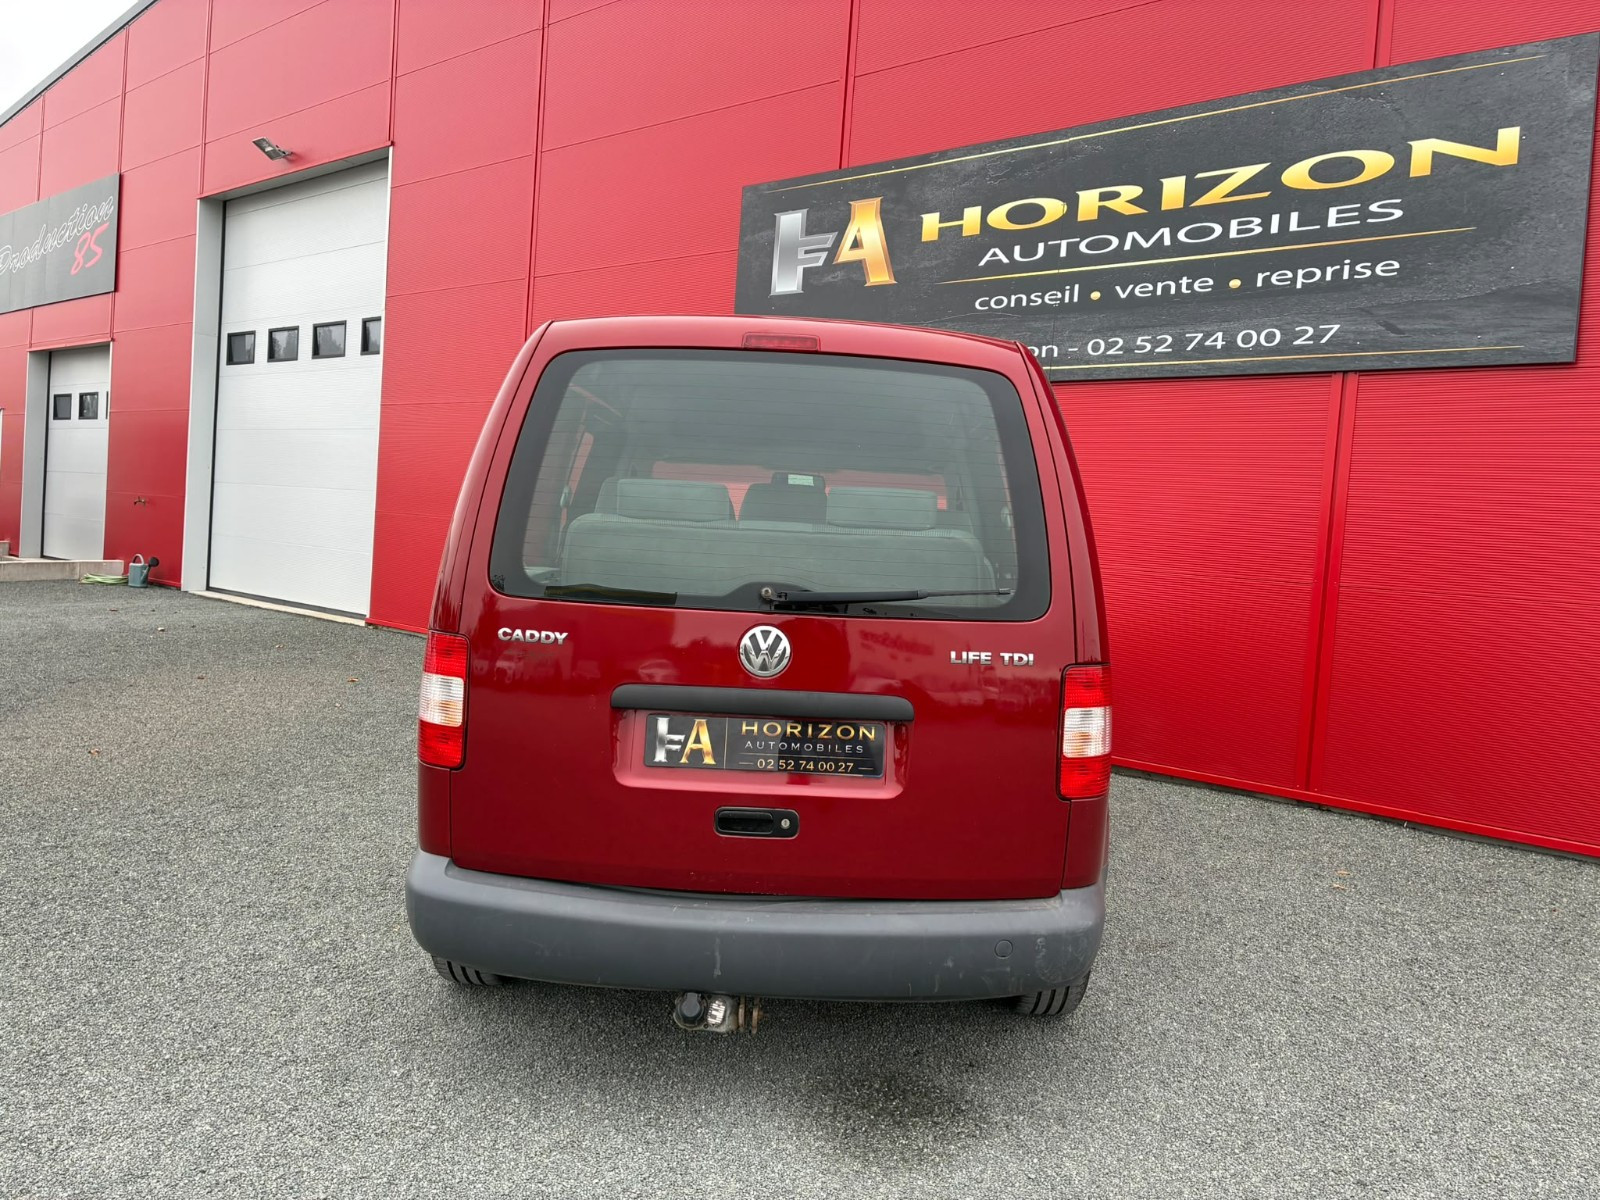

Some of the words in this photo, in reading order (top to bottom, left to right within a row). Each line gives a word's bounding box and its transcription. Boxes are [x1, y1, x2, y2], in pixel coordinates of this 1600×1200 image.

[921, 126, 1521, 242] HORIZON
[978, 198, 1405, 267] AUTOMOBILES
[70, 222, 110, 275] 85
[975, 284, 1079, 310] conseil
[1115, 274, 1215, 299] vente
[1256, 259, 1401, 288] reprise
[1087, 338, 1125, 357] 02
[1134, 334, 1173, 353] 52
[1184, 331, 1227, 350] 74
[1237, 328, 1282, 348] 00
[1293, 324, 1341, 345] 27
[497, 627, 569, 645] CADDY
[950, 651, 993, 666] LIFE
[1000, 652, 1035, 666] TDI
[741, 720, 876, 742] HORIZON
[744, 740, 864, 754] AUTOMOBILES
[757, 758, 774, 770] 02
[778, 759, 795, 770] 52
[799, 760, 815, 771] 74
[818, 761, 835, 772] 00
[838, 762, 854, 773] 27
